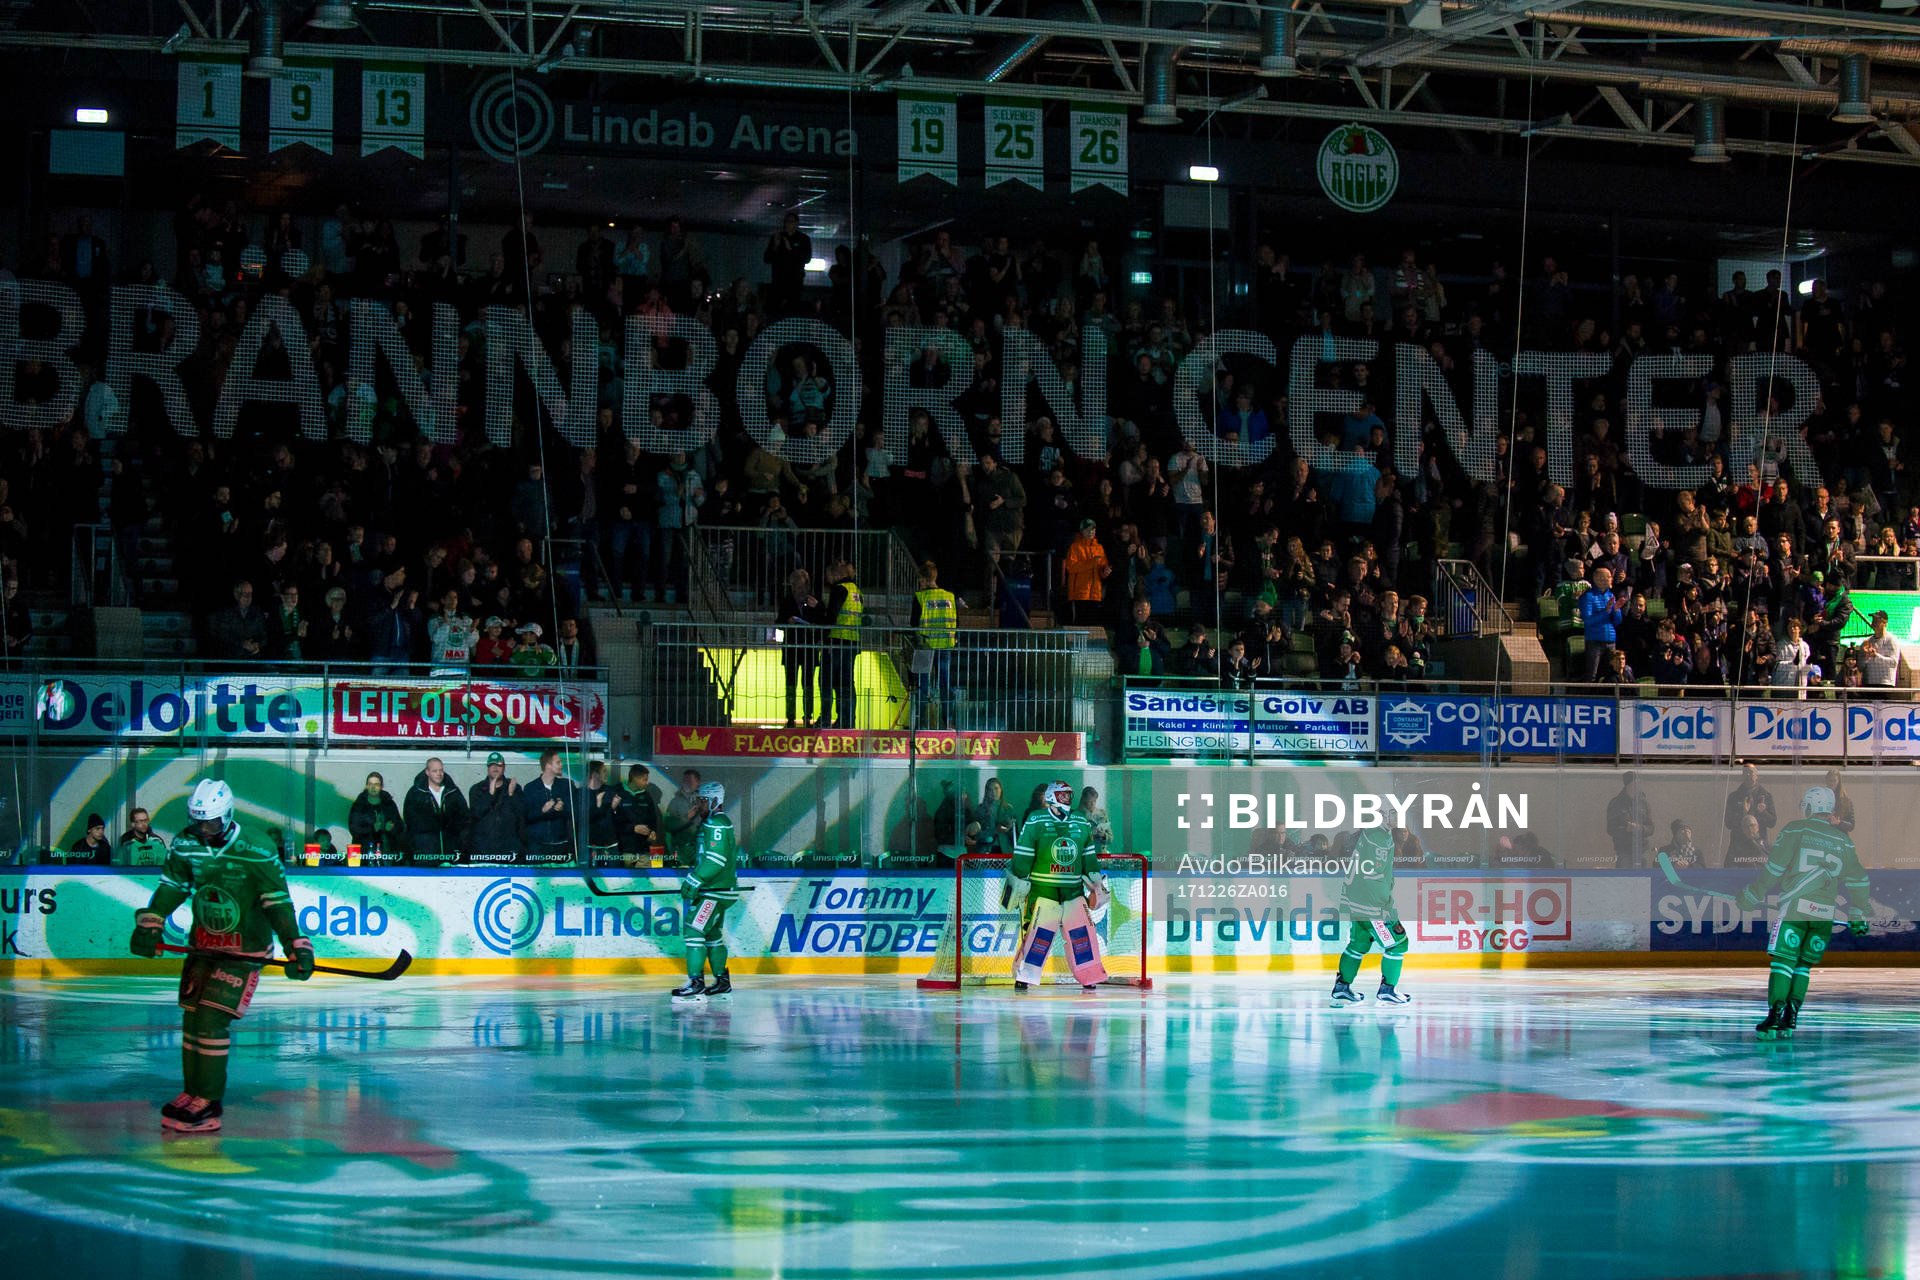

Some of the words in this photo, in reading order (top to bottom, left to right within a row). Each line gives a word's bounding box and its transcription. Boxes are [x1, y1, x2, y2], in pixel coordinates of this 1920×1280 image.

[203, 81, 215, 118] 1
[291, 85, 311, 121] 9
[375, 88, 411, 126] 13
[564, 104, 714, 148] Lindab
[730, 115, 859, 156] Arena
[911, 118, 944, 154] 19
[995, 123, 1035, 159] 25
[1079, 128, 1119, 164] 26
[0, 246, 1110, 469] BRÄNNBORN
[1173, 328, 1825, 491] CENTER
[342, 691, 409, 722] LEIF
[420, 692, 573, 725] OLSSONS
[1263, 697, 1323, 715] Golv
[1332, 698, 1369, 715] AB
[1436, 702, 1612, 725] CONTAINER
[1638, 703, 1716, 740] Diab
[1747, 705, 1832, 741] Diab
[398, 723, 476, 736] MÅLERI
[494, 725, 516, 736] AB
[1157, 720, 1186, 729] Kakel
[1272, 734, 1369, 749] ÄNGELHOLM
[1462, 726, 1587, 748] POOLEN
[733, 734, 907, 755] FLAGGFABRIKEN
[713, 828, 722, 841] 6
[1, 886, 57, 914] urs
[808, 881, 937, 919] Tommy
[1166, 893, 1341, 942] bravida
[1427, 888, 1562, 925] ER-HO
[1458, 928, 1530, 950] BYGG
[211, 967, 243, 988] Jeep
